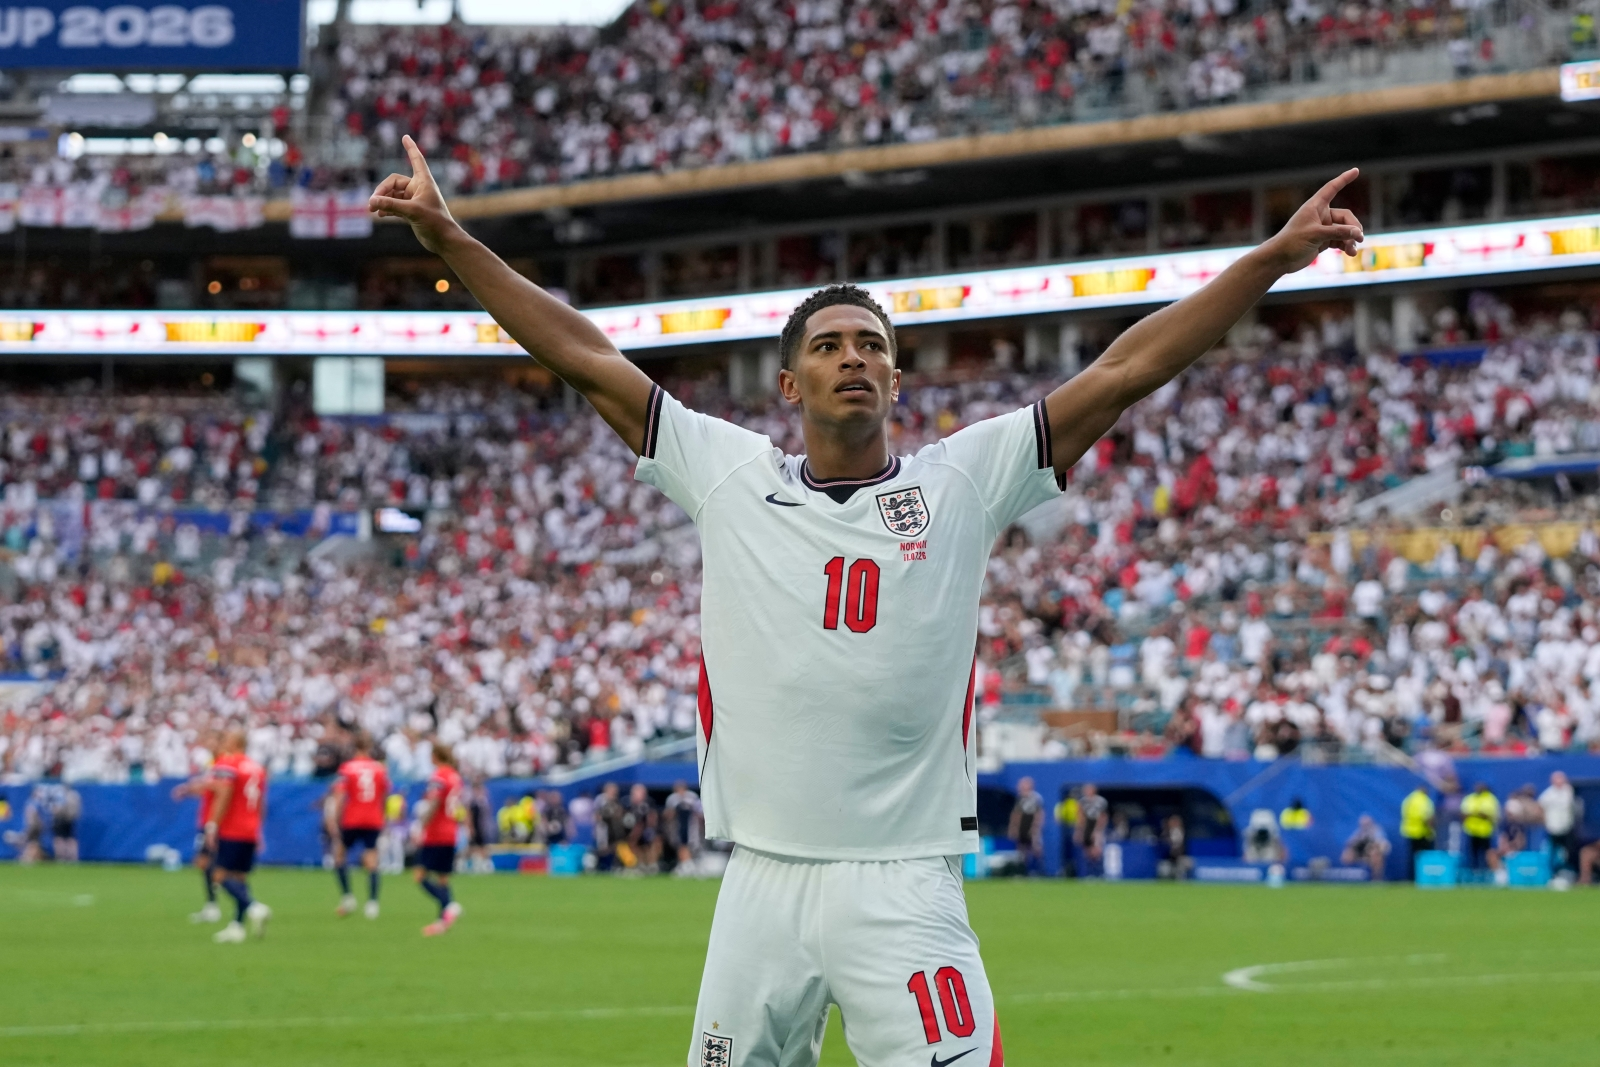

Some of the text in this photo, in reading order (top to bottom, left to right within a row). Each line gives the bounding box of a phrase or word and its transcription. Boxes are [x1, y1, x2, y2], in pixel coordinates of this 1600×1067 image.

[58, 5, 235, 48] 2026
[824, 556, 880, 634] 10
[907, 965, 976, 1045] 10
